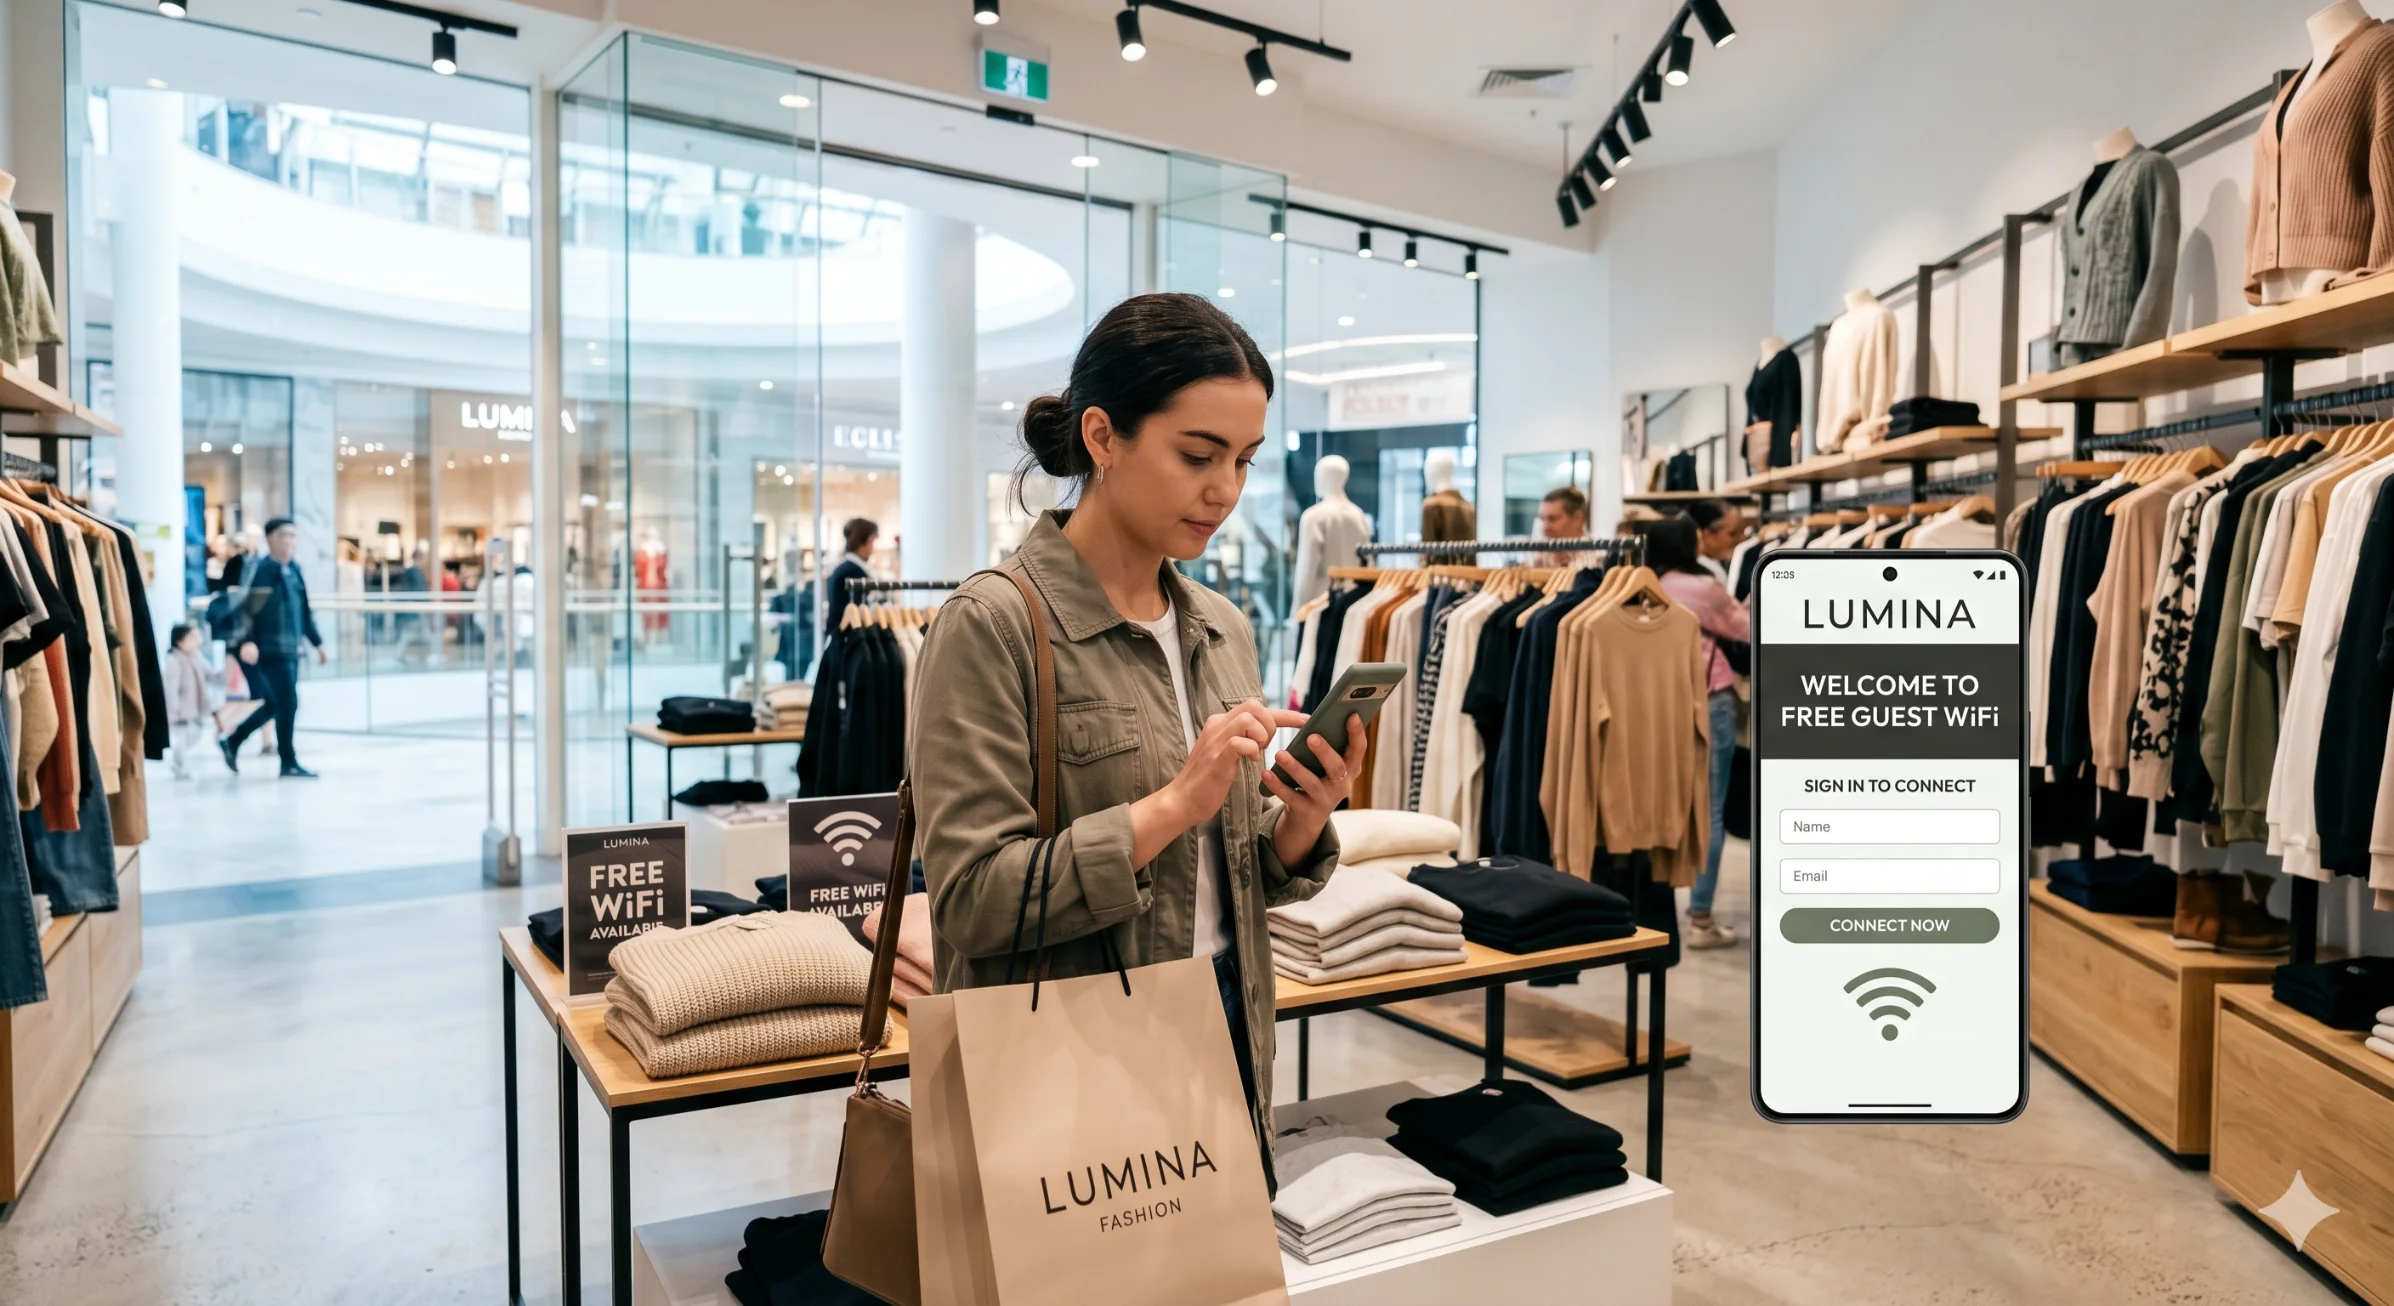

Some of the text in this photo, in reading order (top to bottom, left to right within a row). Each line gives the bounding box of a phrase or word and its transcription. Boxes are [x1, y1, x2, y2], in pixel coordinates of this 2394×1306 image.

[461, 401, 576, 433] LUMIA
[1804, 599, 1976, 629] LUMINA
[1800, 674, 1979, 696] WELCOME TO
[1781, 706, 1999, 727] FREE GUEST WiFi
[1804, 779, 1976, 793] SIGN IN TO CONNECT
[1793, 820, 1831, 833] Name
[603, 836, 650, 849] LUMINA
[590, 860, 664, 890] FREE
[1793, 870, 1828, 882] Email
[590, 888, 664, 922] WiFi
[810, 886, 850, 903] FREE
[1829, 919, 1950, 932] CONNECT NOW
[1040, 1140, 1218, 1215] LUMINA
[1100, 1197, 1182, 1233] FASHION
